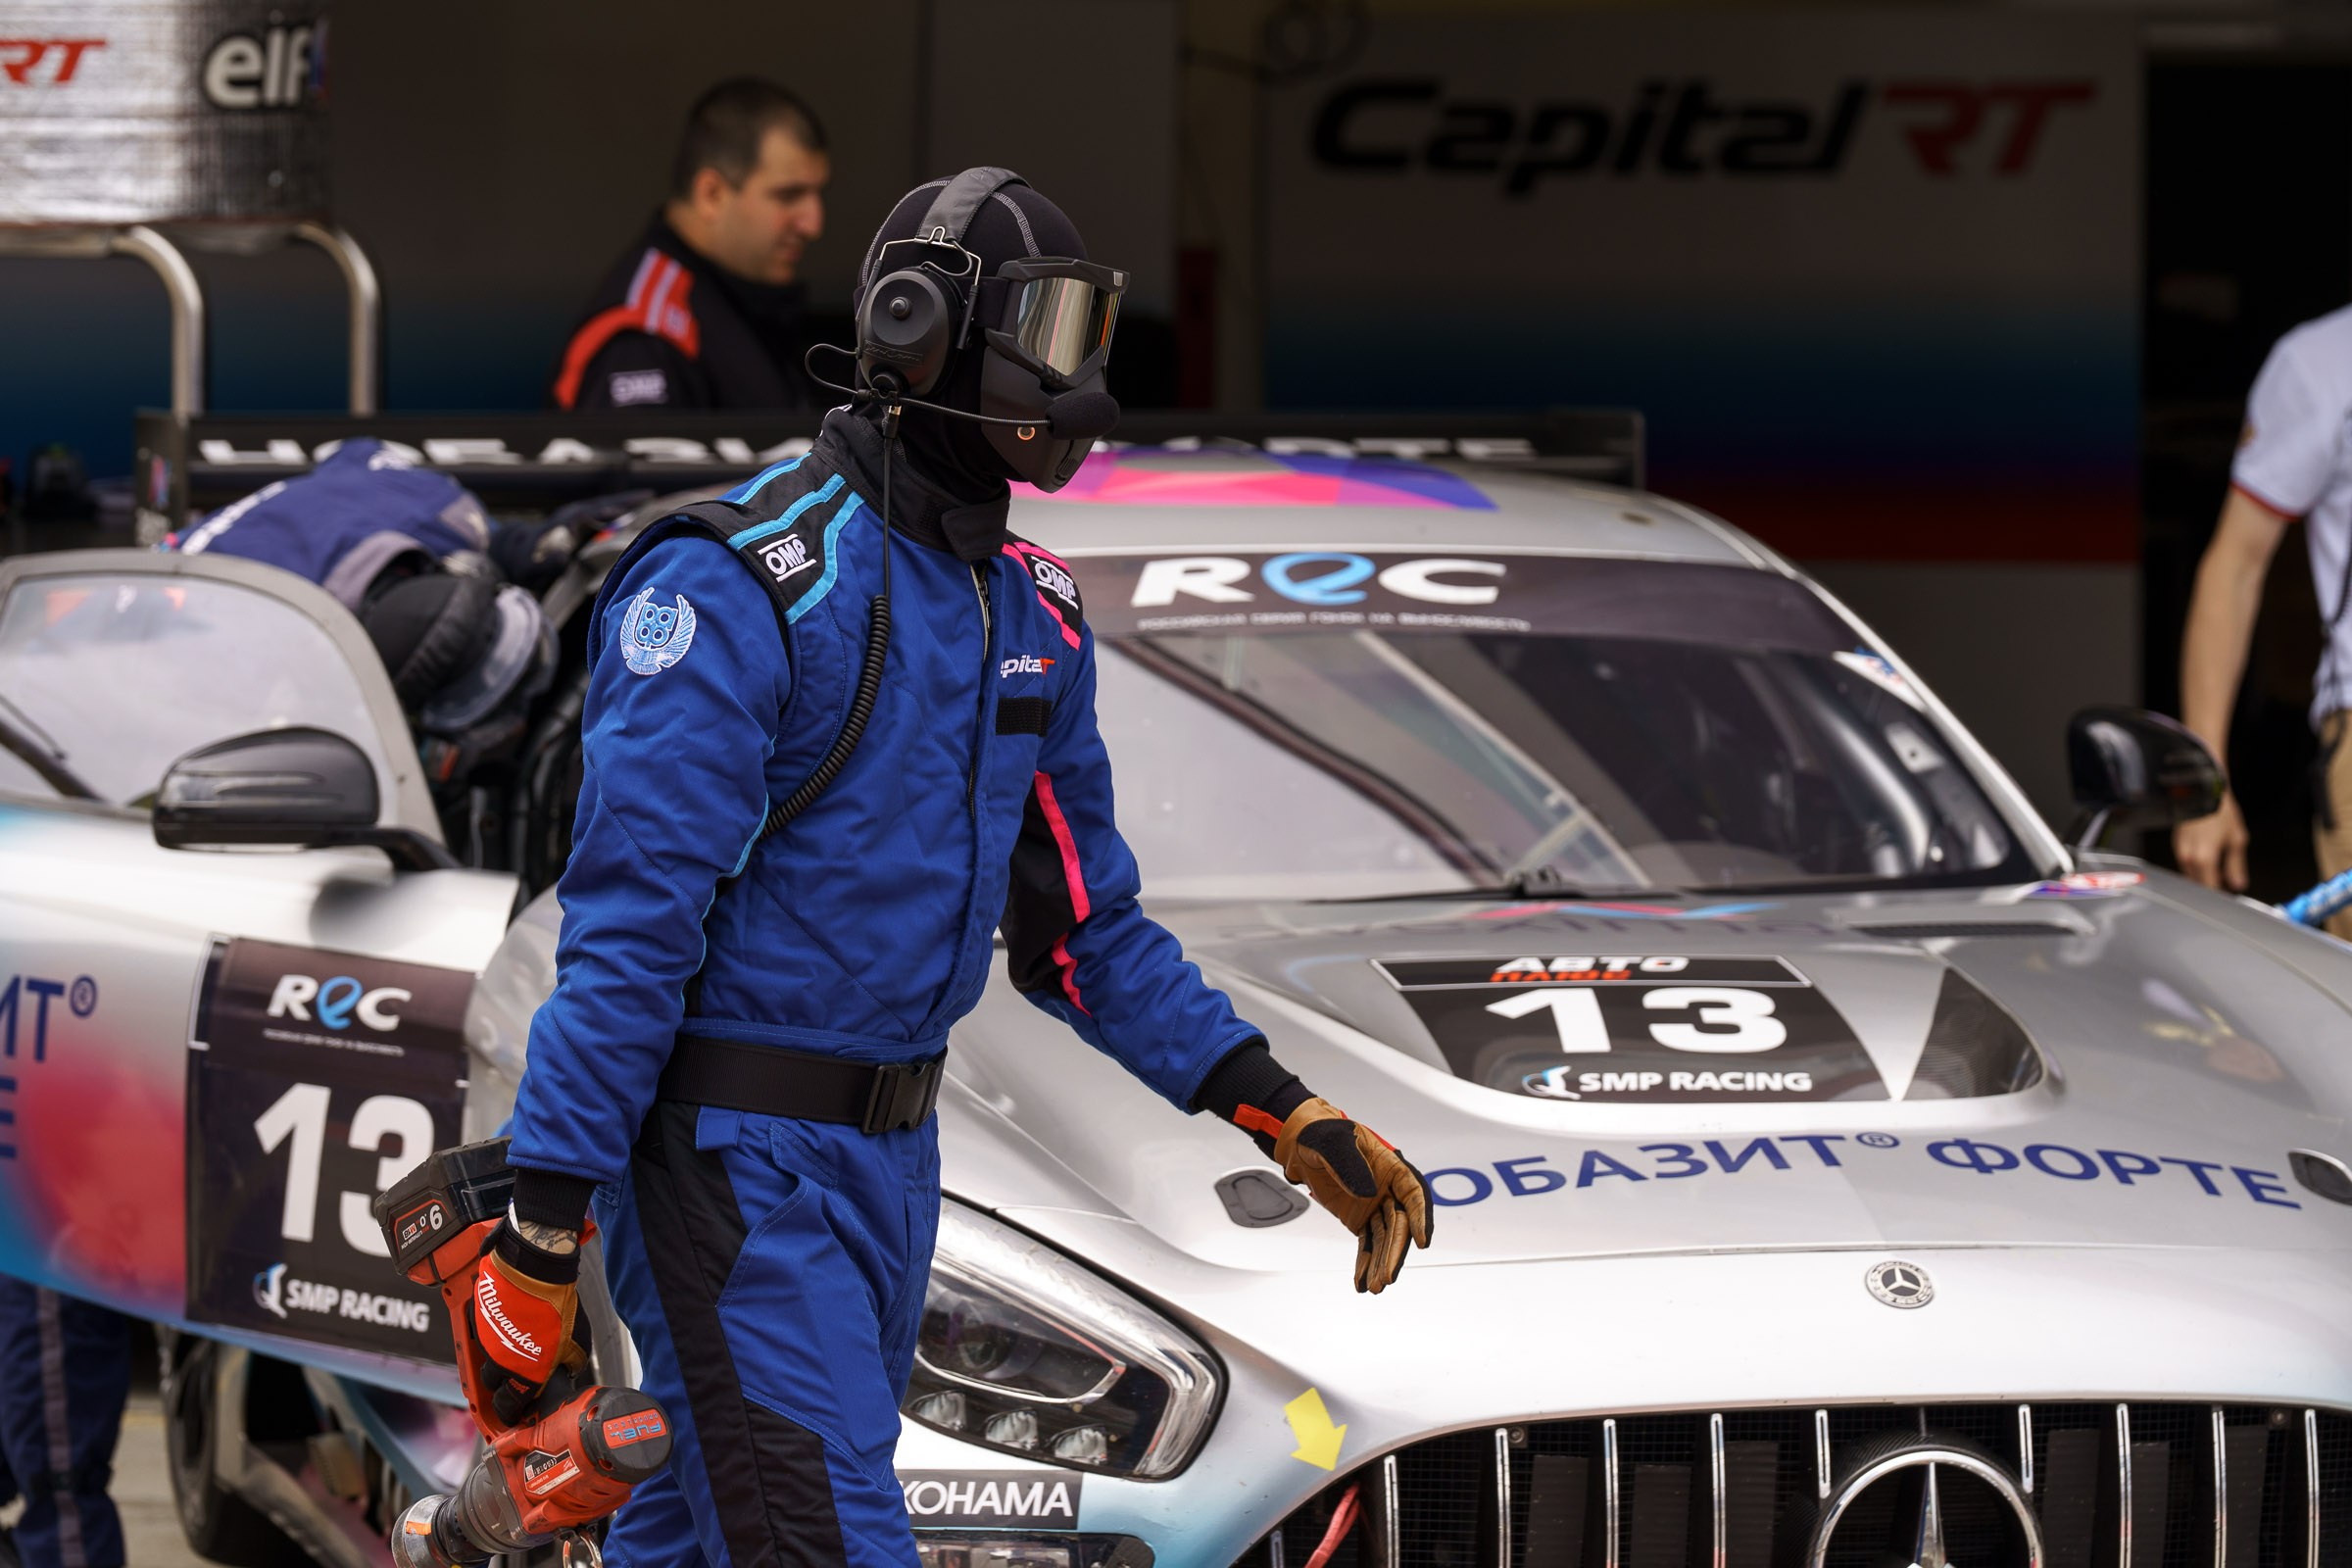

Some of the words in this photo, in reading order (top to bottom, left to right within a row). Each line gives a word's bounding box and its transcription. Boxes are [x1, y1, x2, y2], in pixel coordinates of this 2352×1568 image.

[204, 26, 312, 109] elf
[763, 537, 808, 577] OMP
[1034, 560, 1076, 600] OMP
[1495, 956, 1690, 972] АВТО
[1485, 987, 1788, 1054] 13
[1578, 1071, 1663, 1092] SMP
[1669, 1071, 1812, 1092] RACING
[253, 1083, 435, 1258] 13
[1926, 1138, 2303, 1210] ФОРТЕ
[285, 1278, 340, 1314] SMP
[339, 1289, 431, 1334] RACING
[479, 1270, 542, 1356] Milwaukee
[611, 1421, 662, 1442] FUEL
[900, 1480, 1074, 1517] KOHAMA
